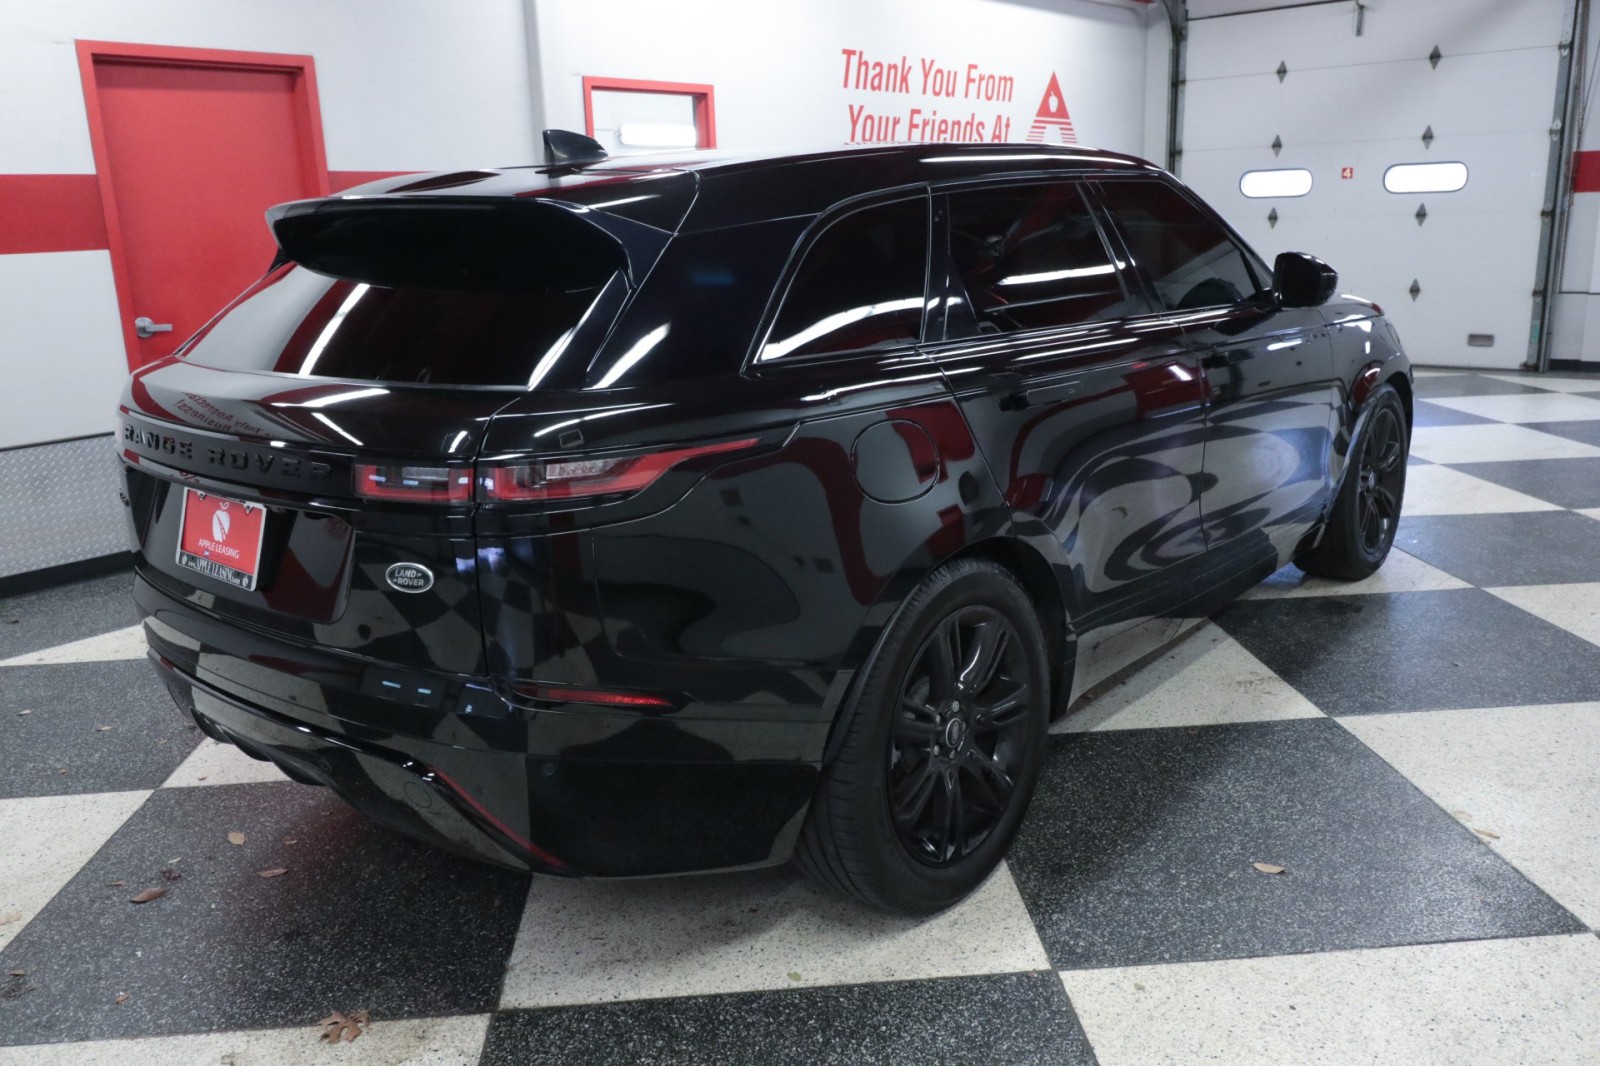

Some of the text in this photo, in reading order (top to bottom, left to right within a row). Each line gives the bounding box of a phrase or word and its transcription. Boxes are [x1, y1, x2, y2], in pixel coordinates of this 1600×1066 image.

[841, 48, 1014, 103] Thank You From
[848, 104, 1011, 143] Your Friends At
[124, 424, 332, 477] RANGE ROVER
[198, 538, 240, 559] APPLE LEASING
